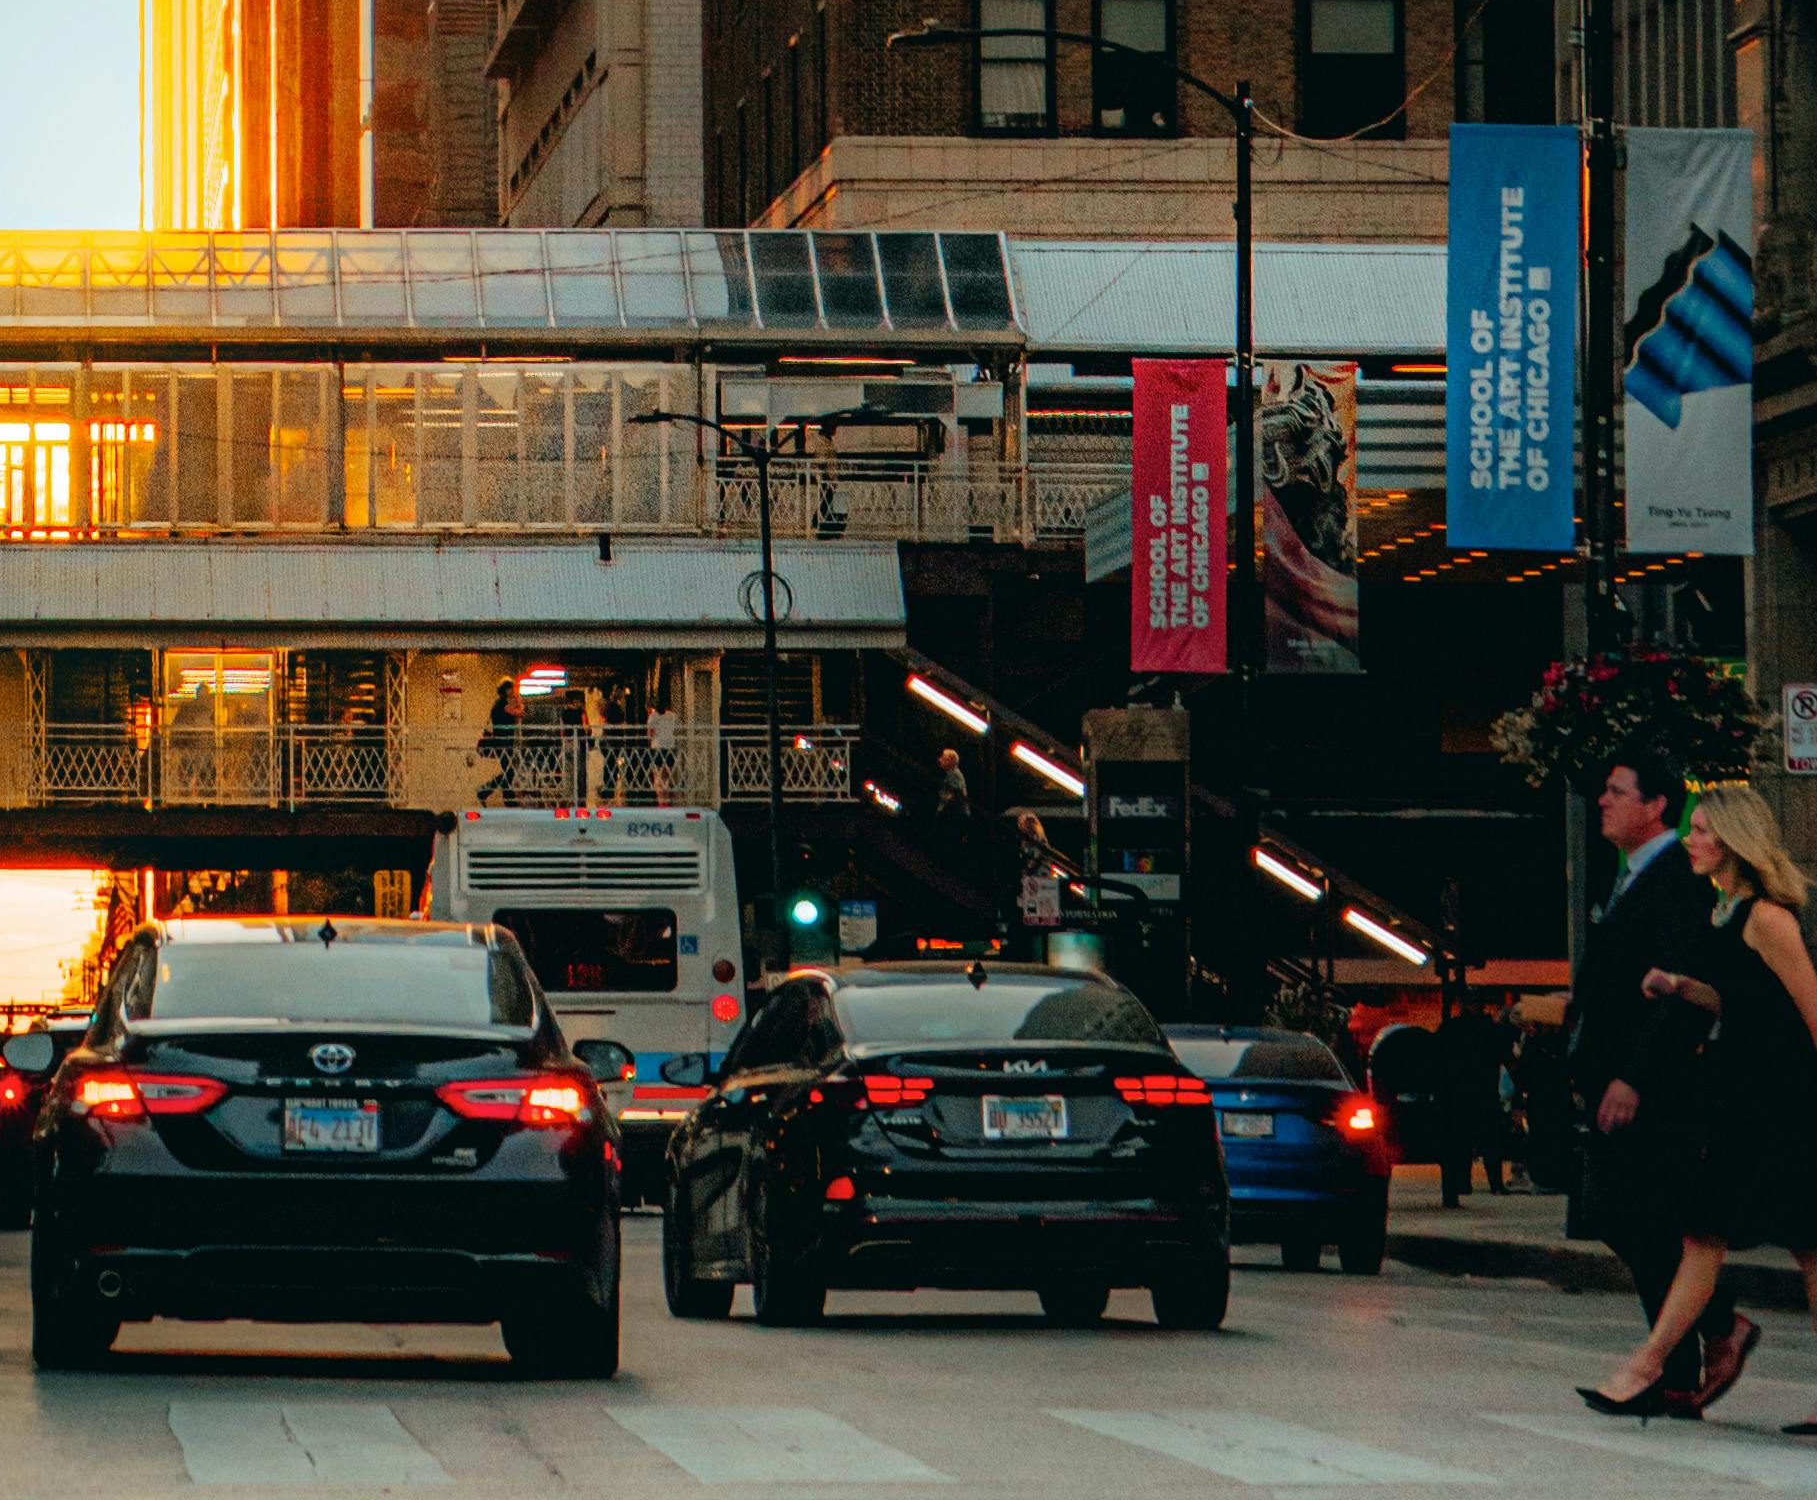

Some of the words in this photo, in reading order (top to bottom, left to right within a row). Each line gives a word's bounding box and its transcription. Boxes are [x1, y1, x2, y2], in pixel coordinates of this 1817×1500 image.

[1500, 187, 1524, 350] INSTITUTE
[1471, 309, 1494, 353] OF
[1499, 356, 1521, 421] ART
[1526, 298, 1551, 441] CHICAGO
[1470, 360, 1493, 490] SCHOOL
[1171, 404, 1189, 525] INSTITUTE
[1498, 428, 1521, 490] THE
[1526, 447, 1550, 492] OF
[1150, 494, 1167, 527] OF
[1192, 485, 1209, 591] CHICAGO
[1171, 528, 1188, 577] ART
[1150, 532, 1167, 629] SCHOOL
[1171, 582, 1188, 629] THE
[1192, 596, 1209, 629] OF
[627, 823, 675, 837] 8264
[1108, 795, 1167, 818] FedEx
